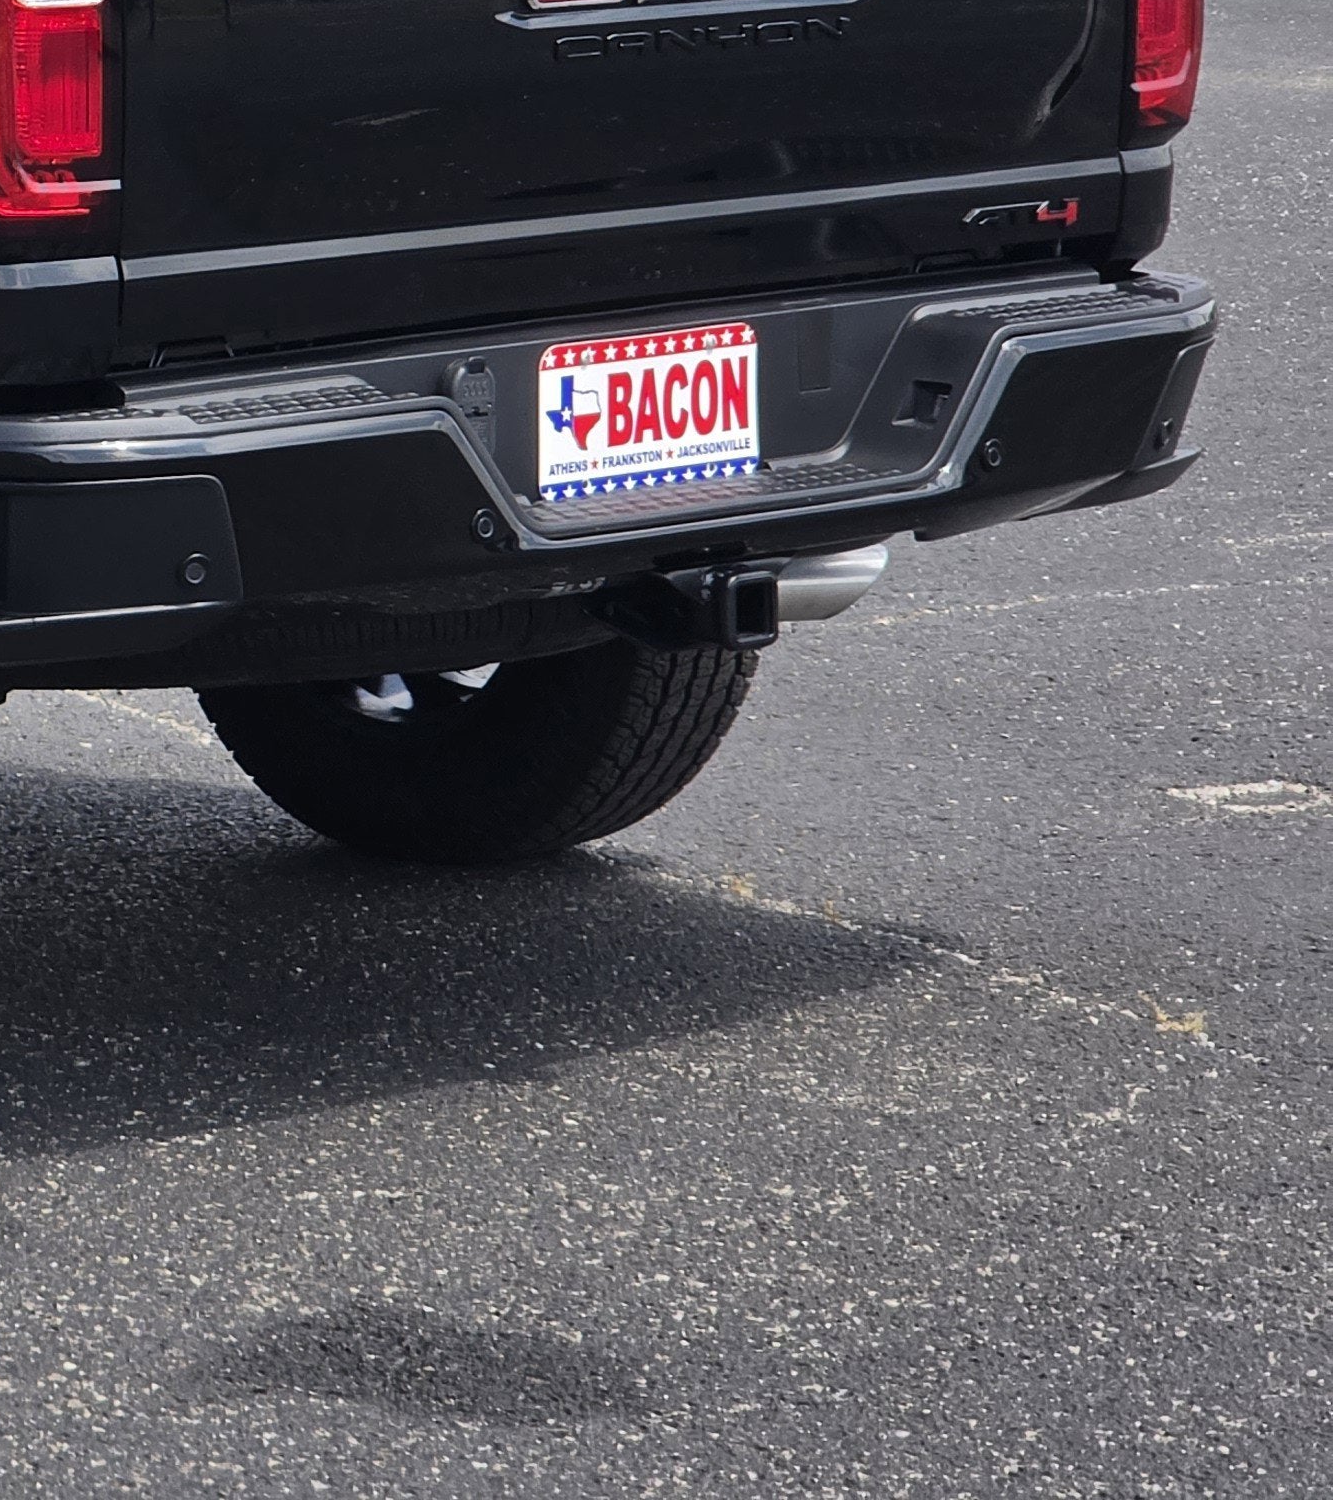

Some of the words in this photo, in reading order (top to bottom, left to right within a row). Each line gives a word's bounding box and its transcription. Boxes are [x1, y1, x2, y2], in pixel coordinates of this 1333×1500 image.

[553, 16, 851, 60] CANYON
[606, 355, 749, 448] BACON
[548, 459, 588, 477] ATHENS
[602, 449, 663, 469] FRANKSTON
[676, 437, 751, 459] JACKSONVILLE
